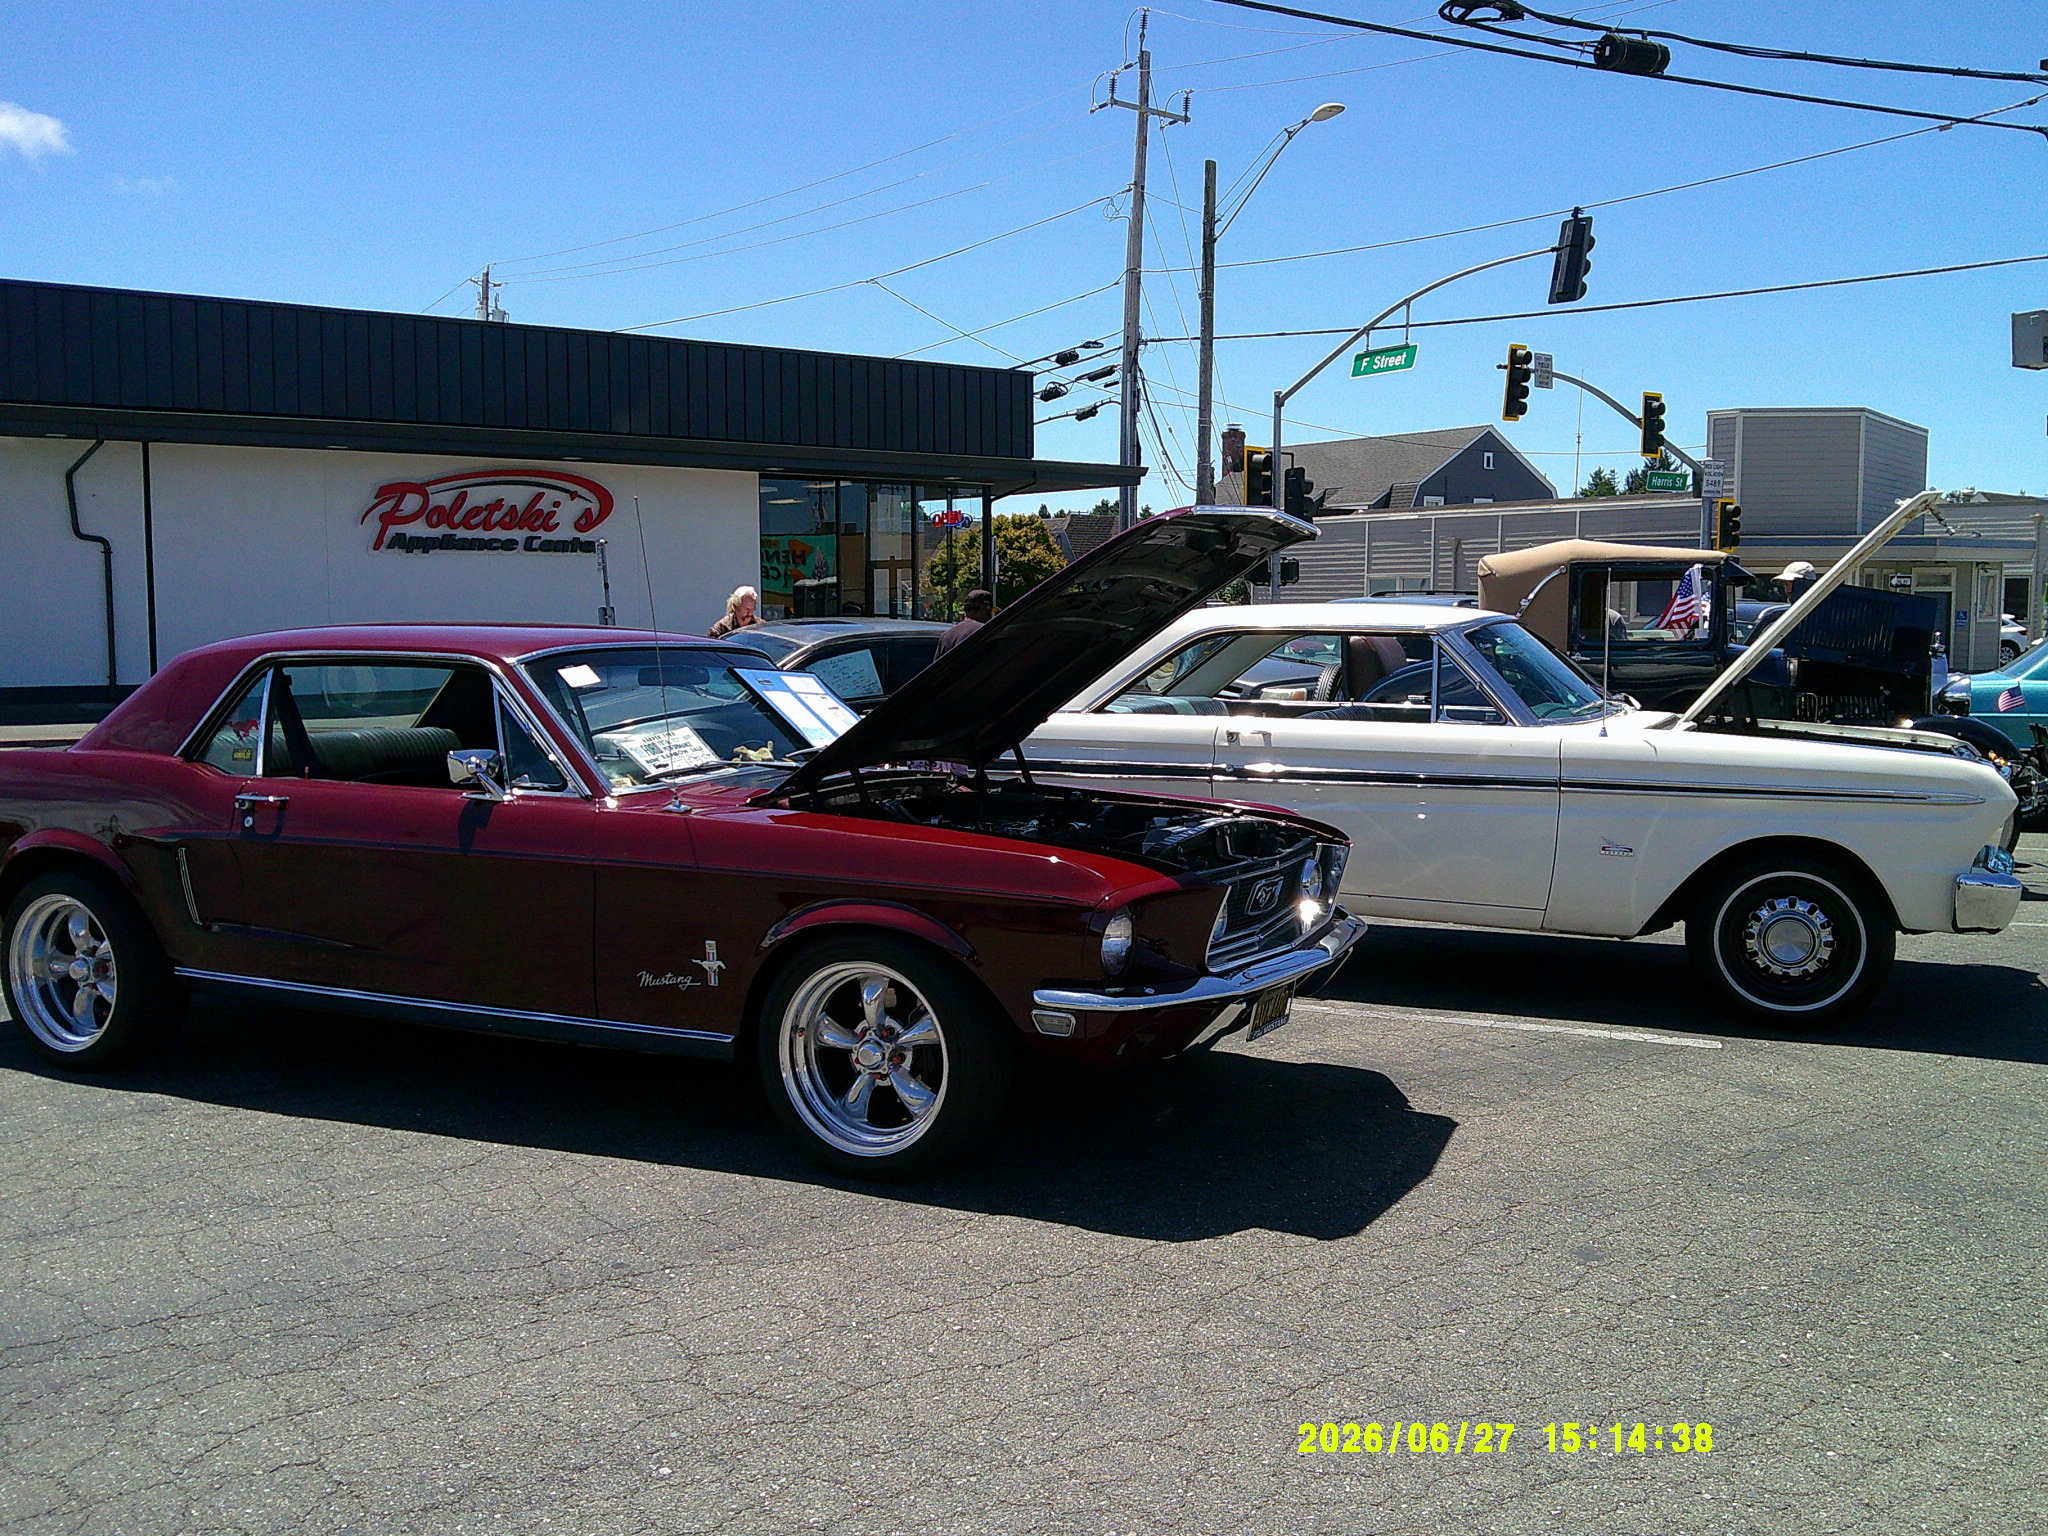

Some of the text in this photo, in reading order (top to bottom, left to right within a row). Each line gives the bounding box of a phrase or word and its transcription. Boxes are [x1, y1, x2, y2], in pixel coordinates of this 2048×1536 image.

[1361, 351, 1407, 371] F Street
[1651, 476, 1683, 487] Harris St
[361, 480, 597, 550] Poletski's
[387, 532, 597, 553] Appliance Cente
[637, 971, 702, 990] Mustang
